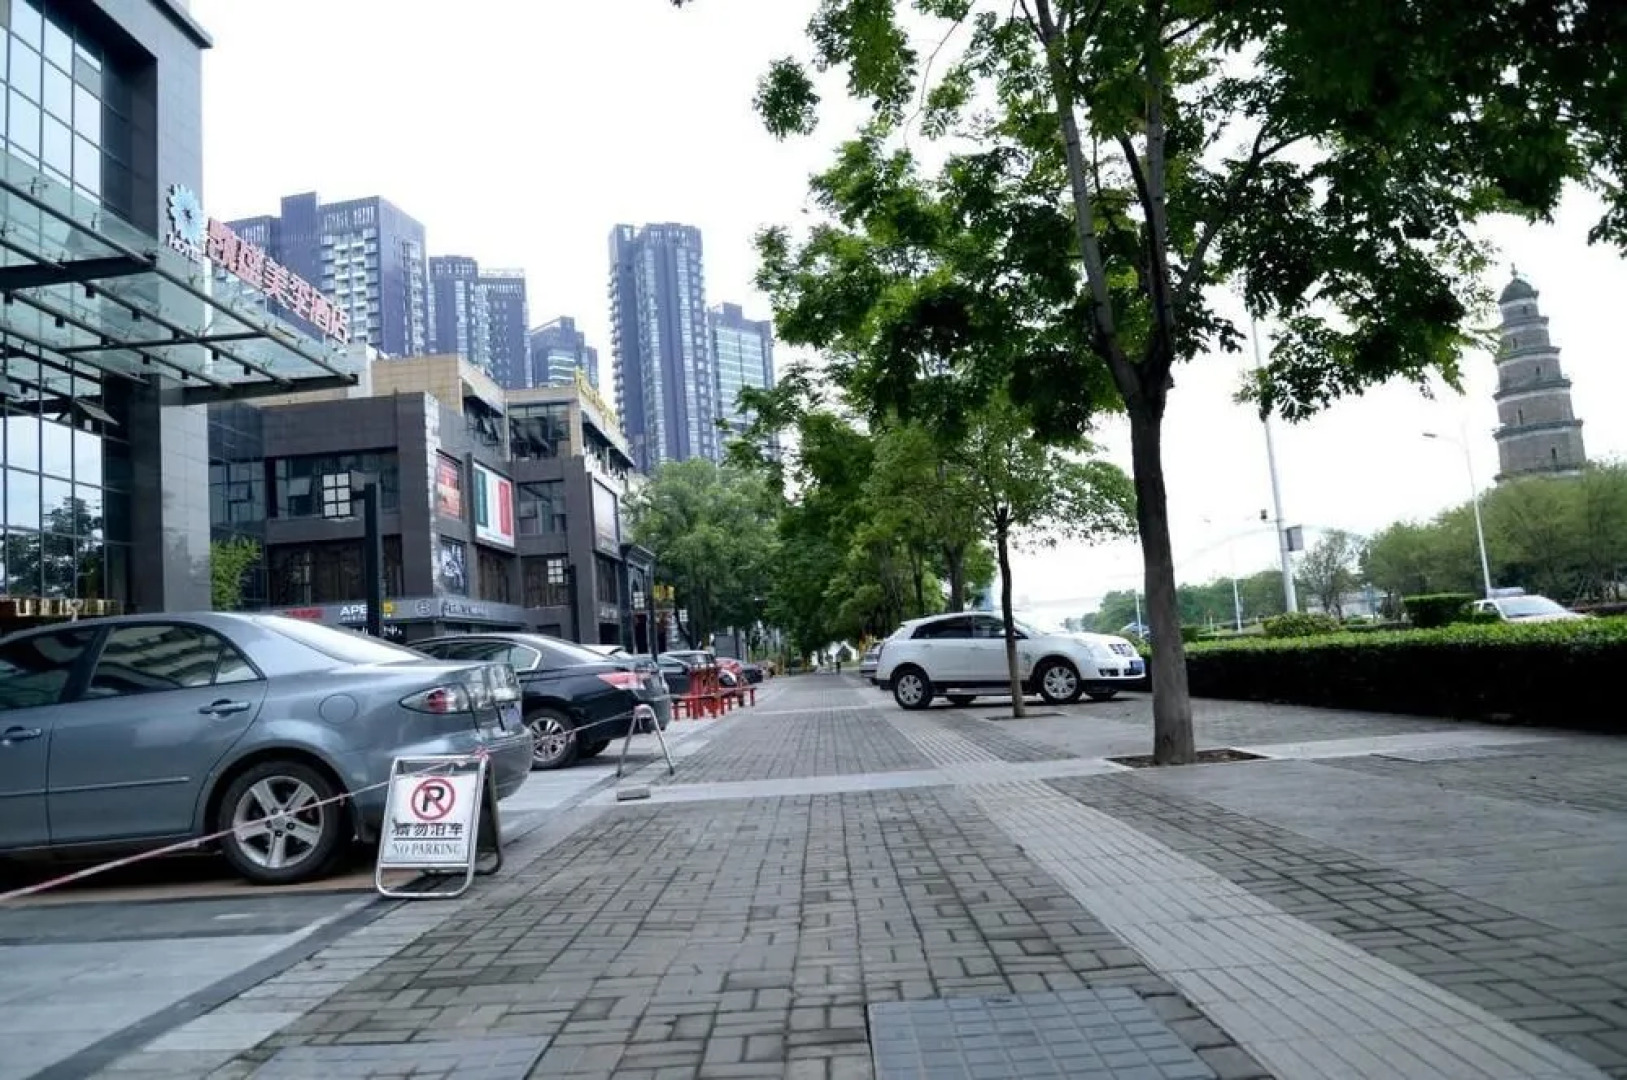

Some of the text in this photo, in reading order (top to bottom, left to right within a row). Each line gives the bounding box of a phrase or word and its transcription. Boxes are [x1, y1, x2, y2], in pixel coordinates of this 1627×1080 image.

[391, 818, 463, 837] 请勿泊车
[392, 842, 461, 855] NO PARKING
